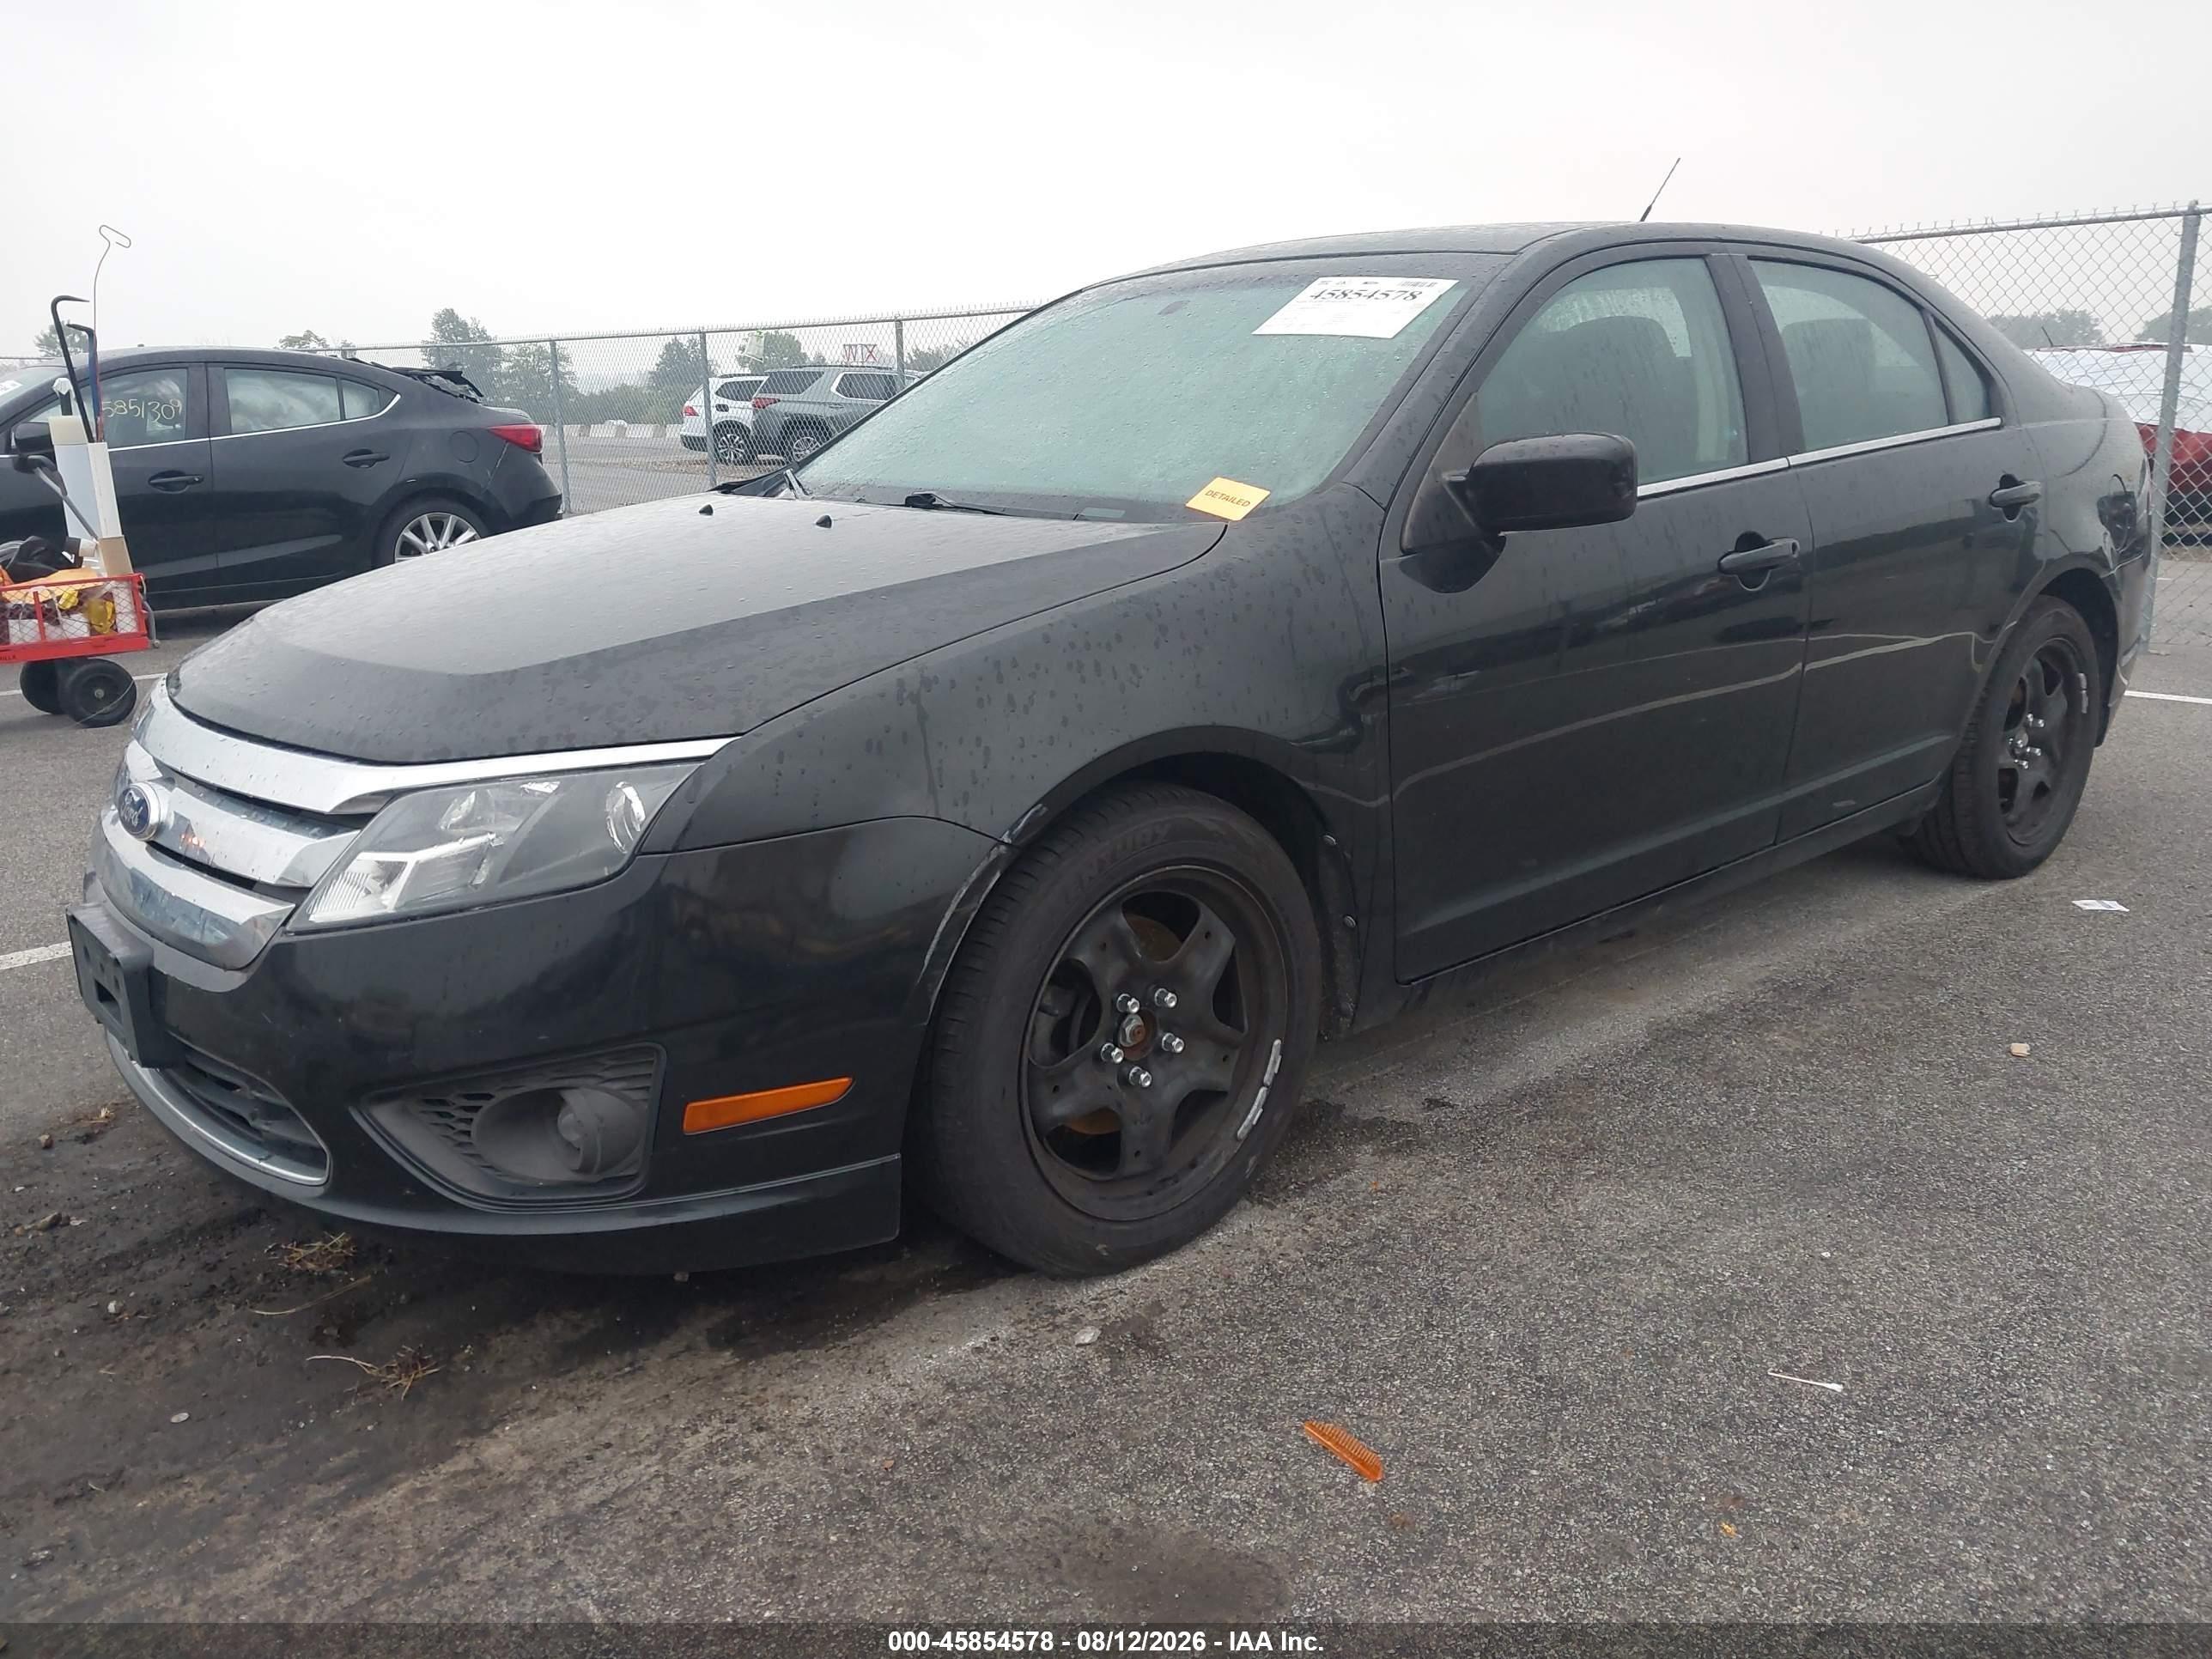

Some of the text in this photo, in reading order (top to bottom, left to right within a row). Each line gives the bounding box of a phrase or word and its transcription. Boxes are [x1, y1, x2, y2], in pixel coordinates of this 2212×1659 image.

[1310, 289, 1423, 301] 45854578
[1204, 489, 1251, 507] DETAILED
[120, 790, 143, 827] Ford
